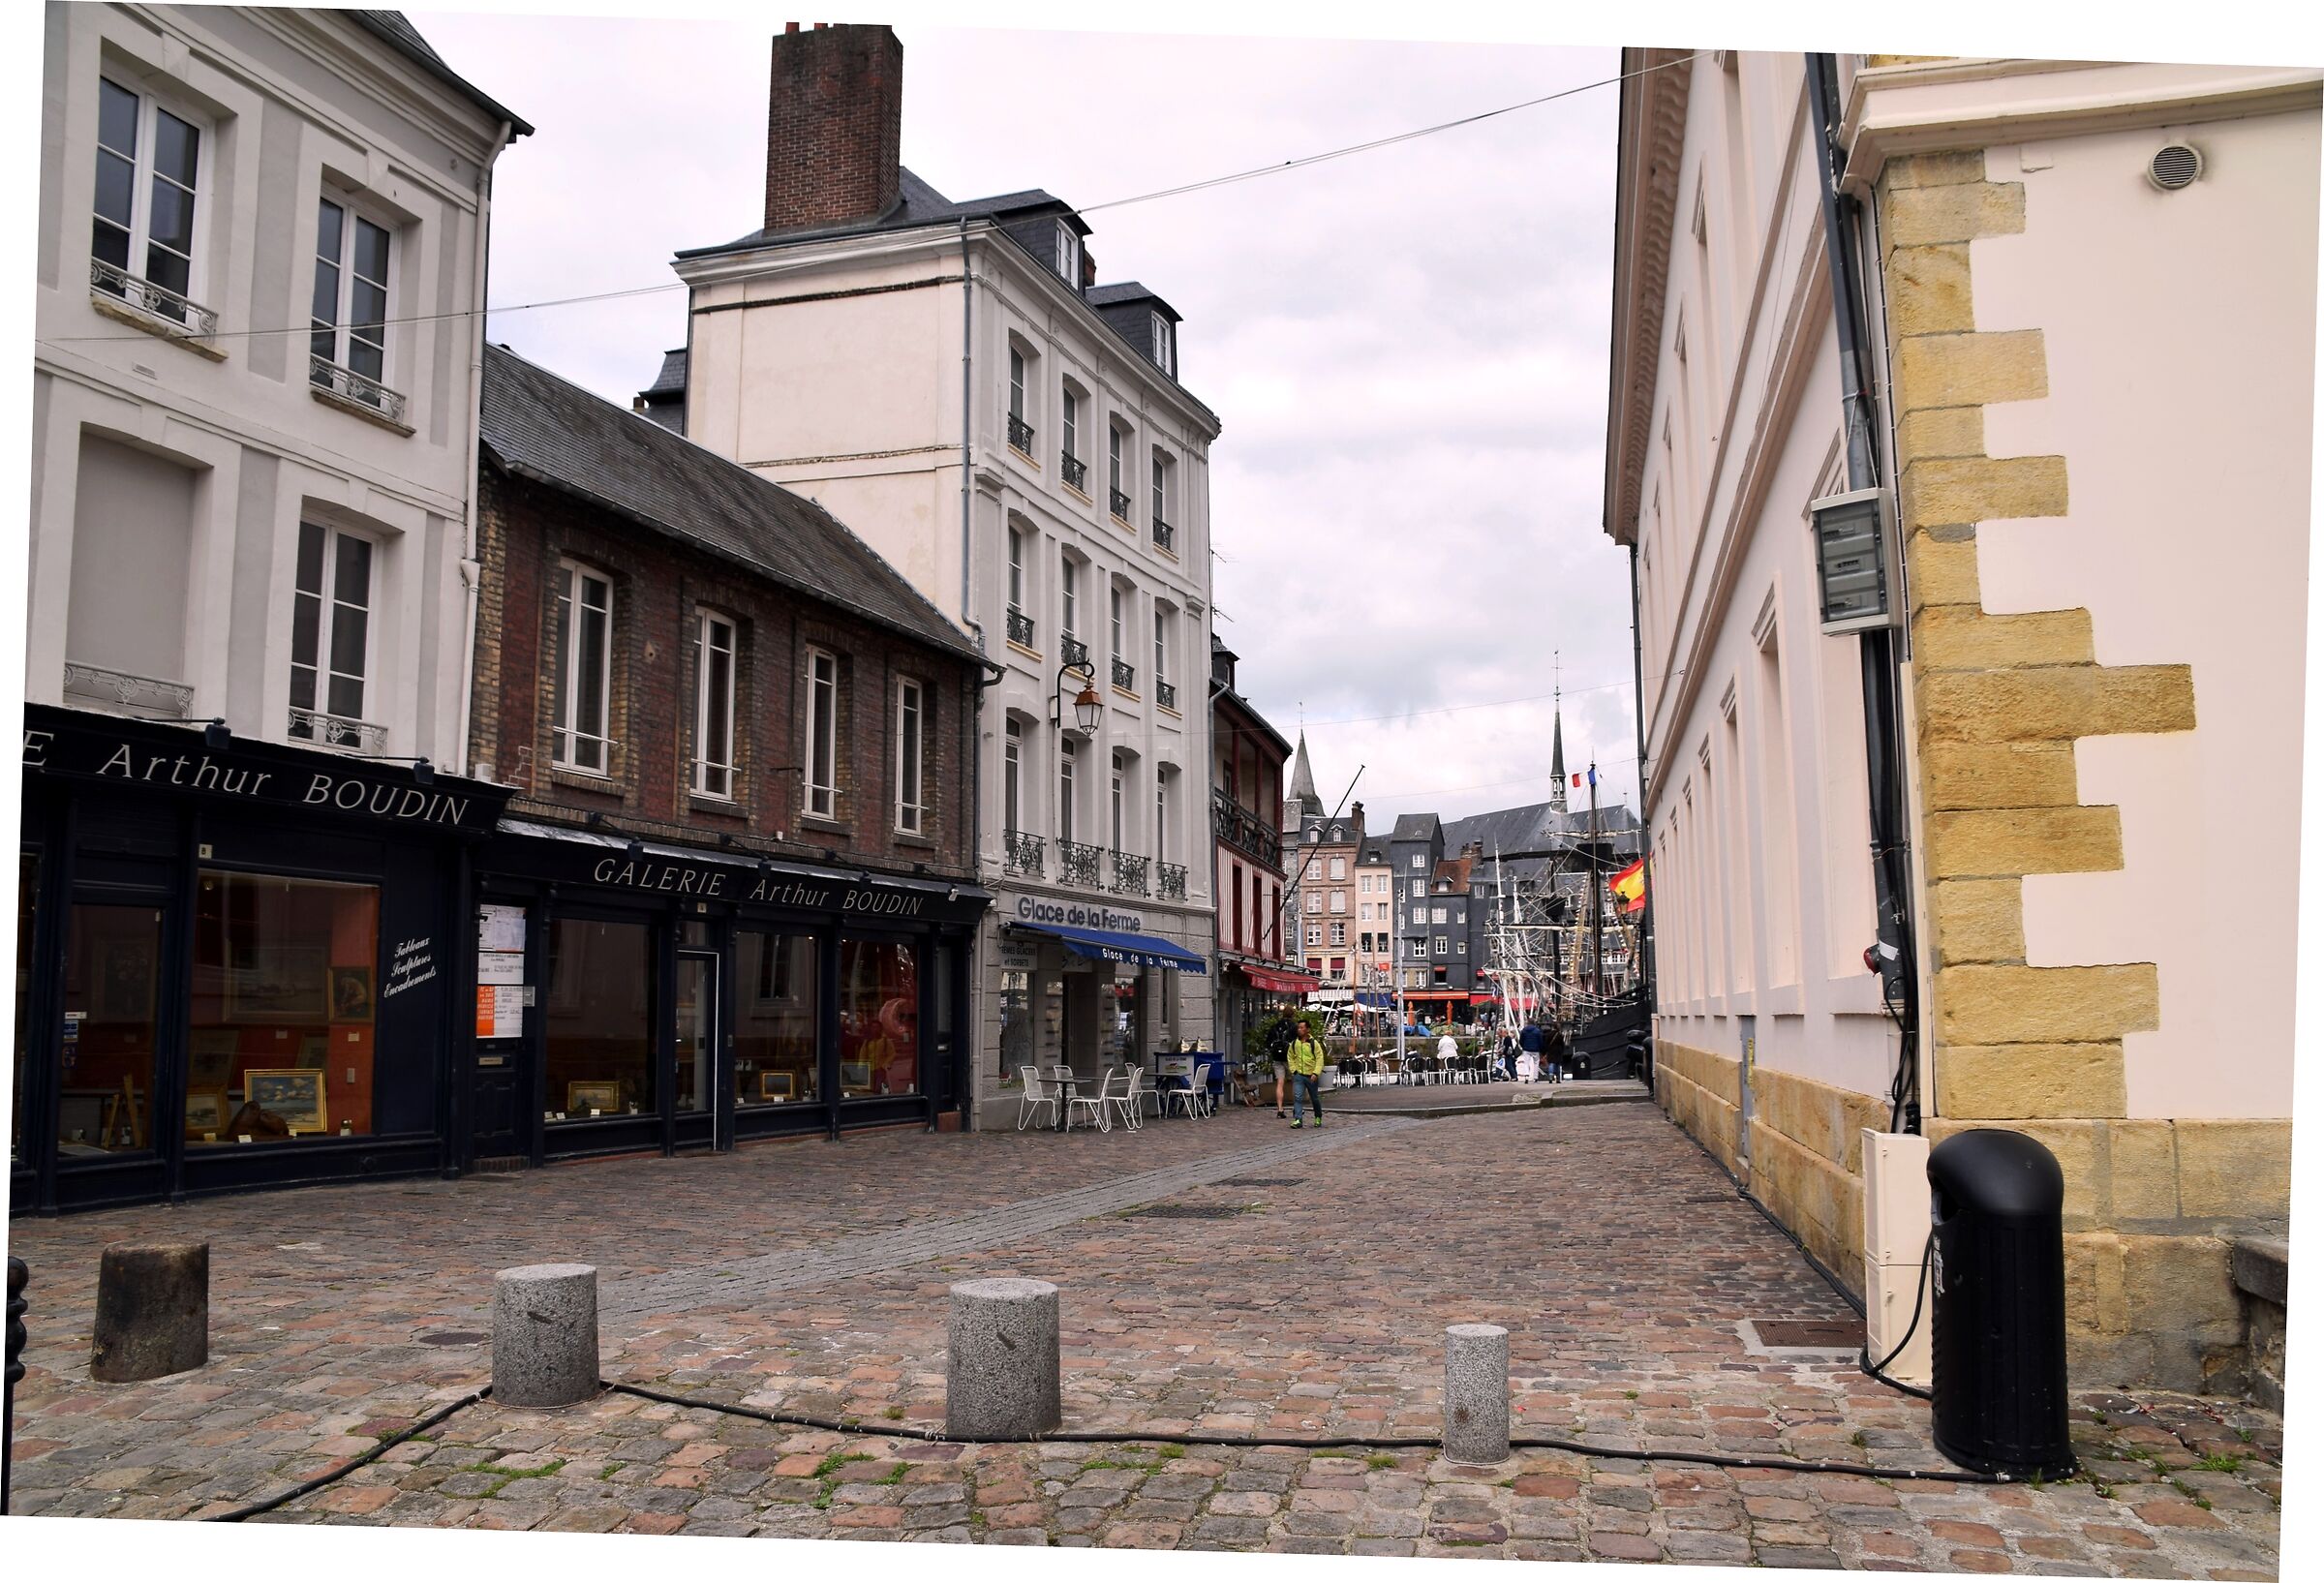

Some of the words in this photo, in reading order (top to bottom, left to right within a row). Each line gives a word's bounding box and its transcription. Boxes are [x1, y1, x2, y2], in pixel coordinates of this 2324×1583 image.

[22, 729, 54, 767] E
[96, 744, 271, 796] Arthur
[302, 774, 470, 825] BOUDIN
[594, 858, 726, 896] GALERIE
[749, 878, 829, 906] Arthur
[842, 890, 924, 915] BOUDIN
[1018, 897, 1064, 923] Glace
[1067, 905, 1086, 925] de
[1087, 907, 1100, 928] la
[1101, 908, 1141, 931] Ferme
[395, 937, 430, 959] Tableaux
[1102, 948, 1123, 960] Glace
[1130, 953, 1139, 963] de
[1159, 957, 1178, 968] Ferme
[391, 954, 432, 977] Sculptures
[384, 966, 437, 998] Encadrements
